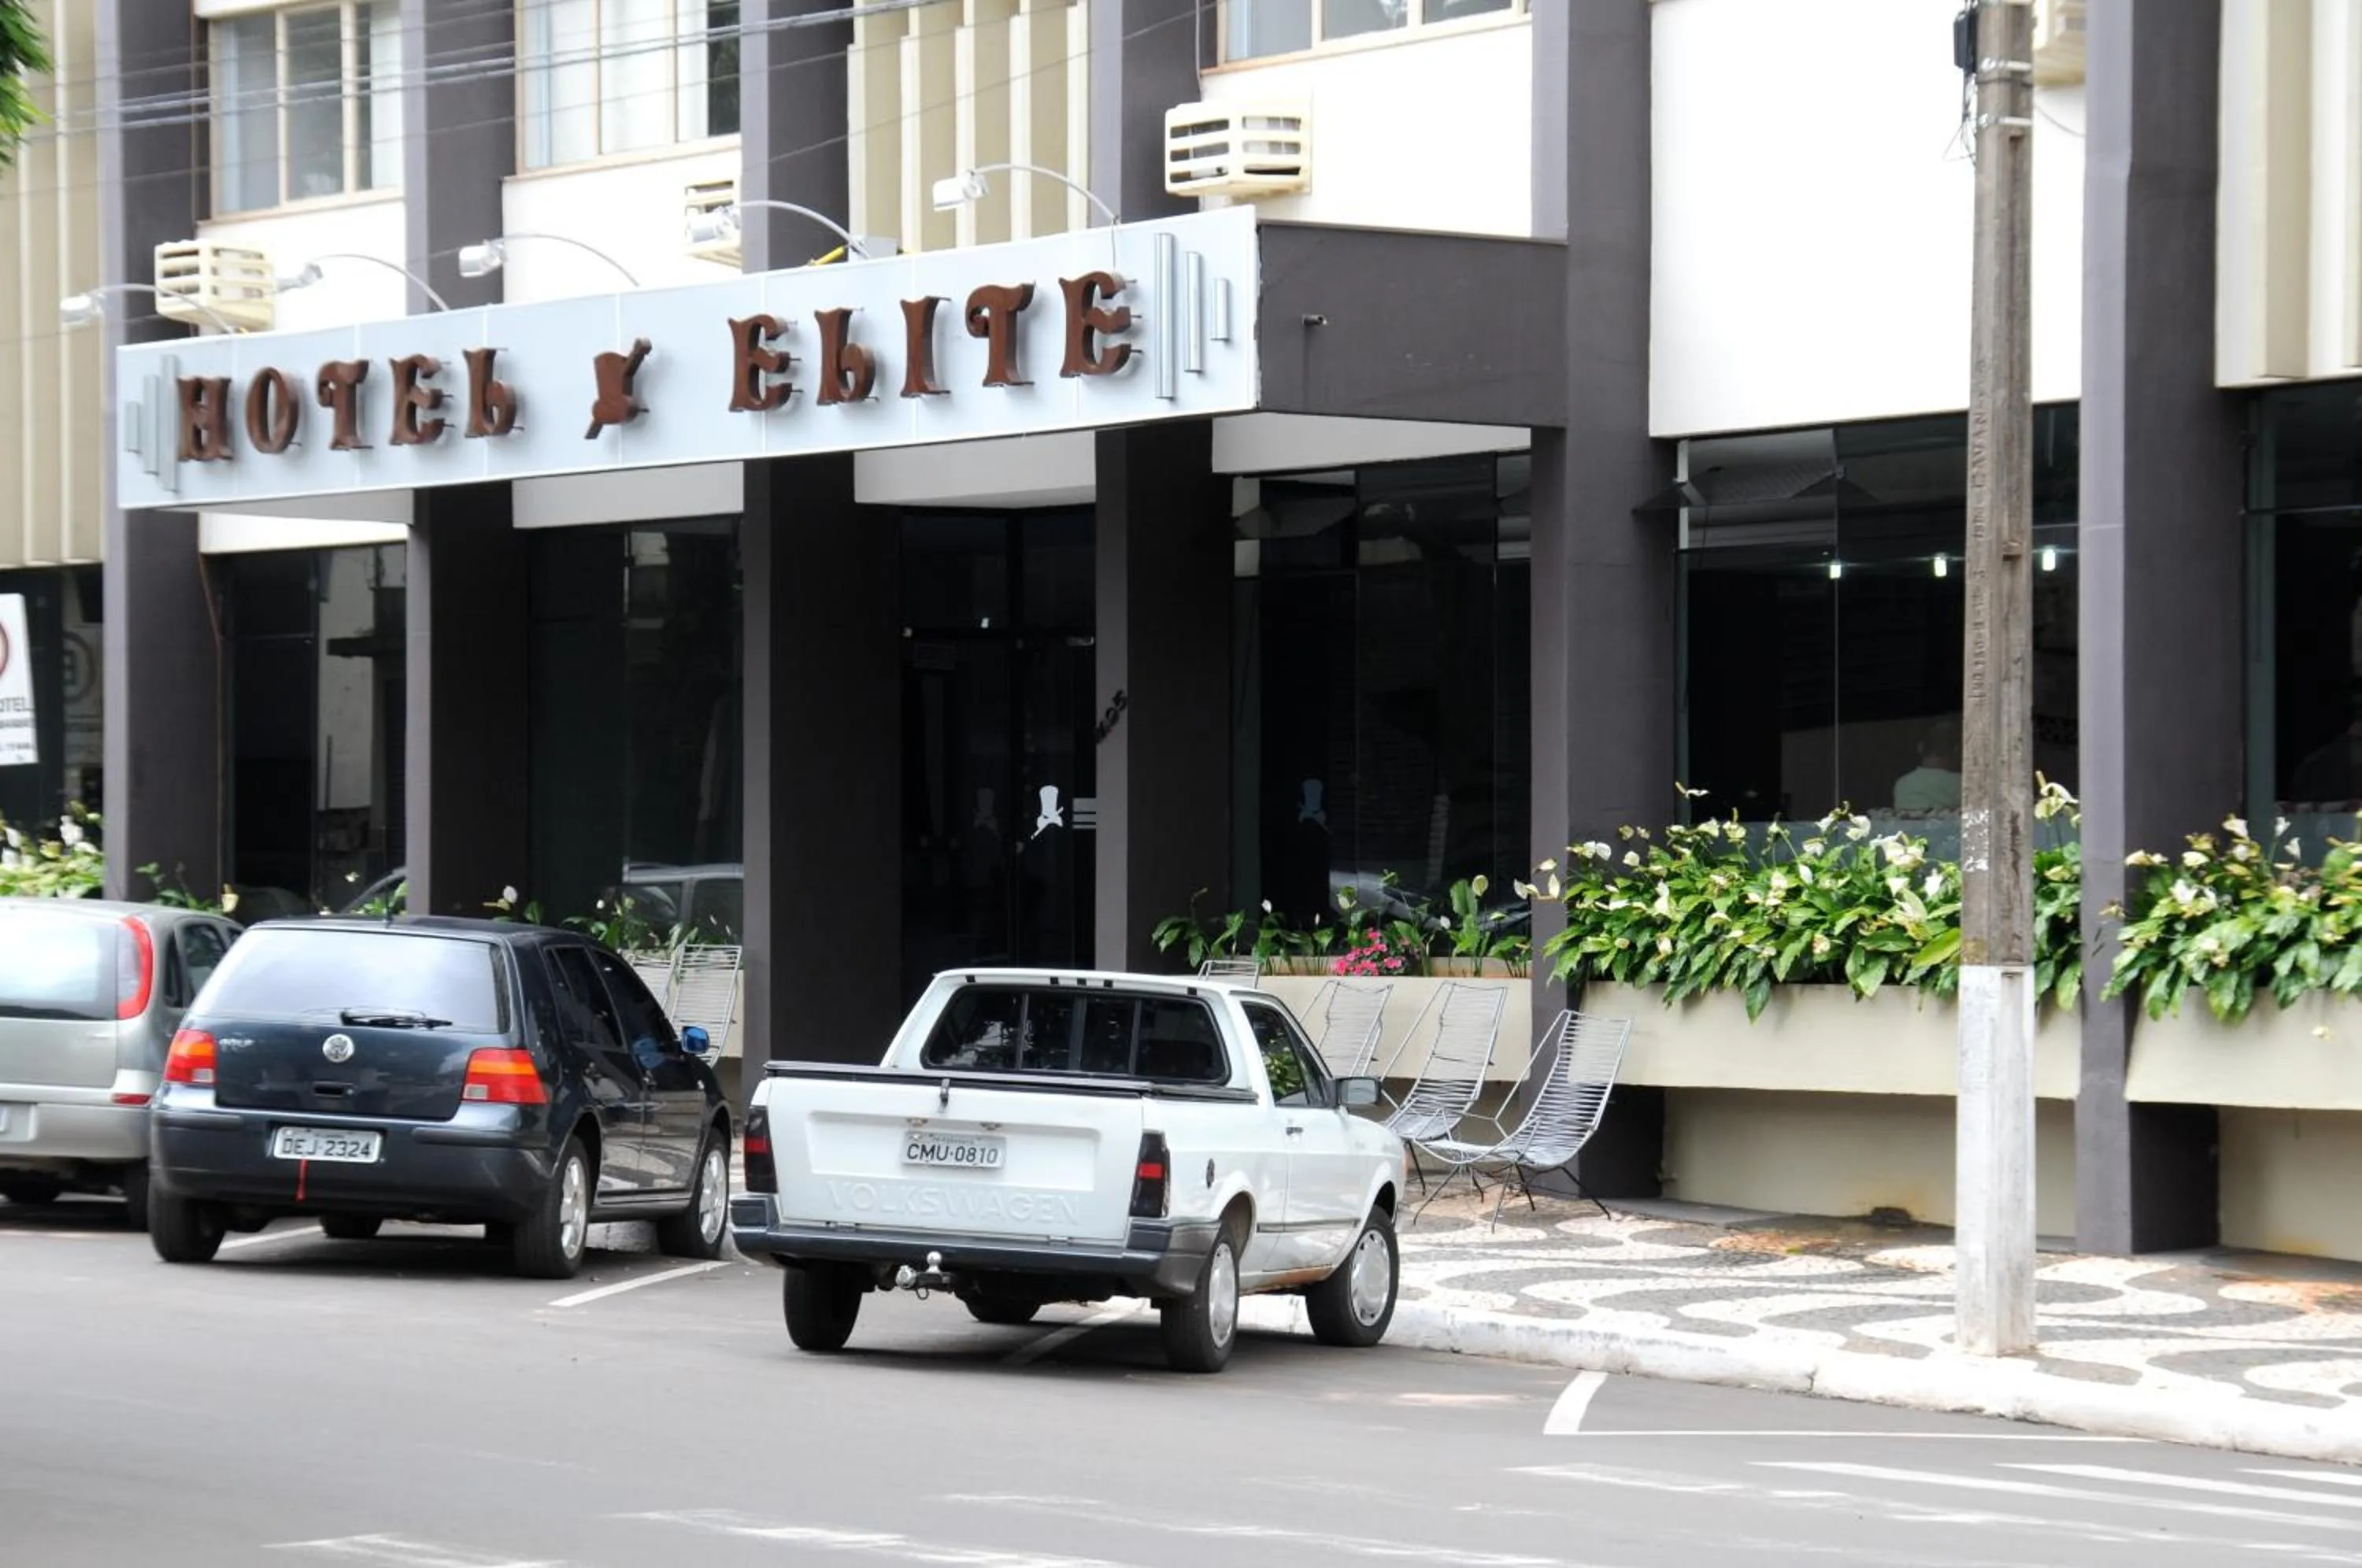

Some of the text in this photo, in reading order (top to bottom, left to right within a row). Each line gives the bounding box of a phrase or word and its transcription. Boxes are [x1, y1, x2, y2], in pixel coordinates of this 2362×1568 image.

[177, 271, 1137, 464] HOTEL ELITE
[824, 1180, 1081, 1226] VOLKSWAGEN
